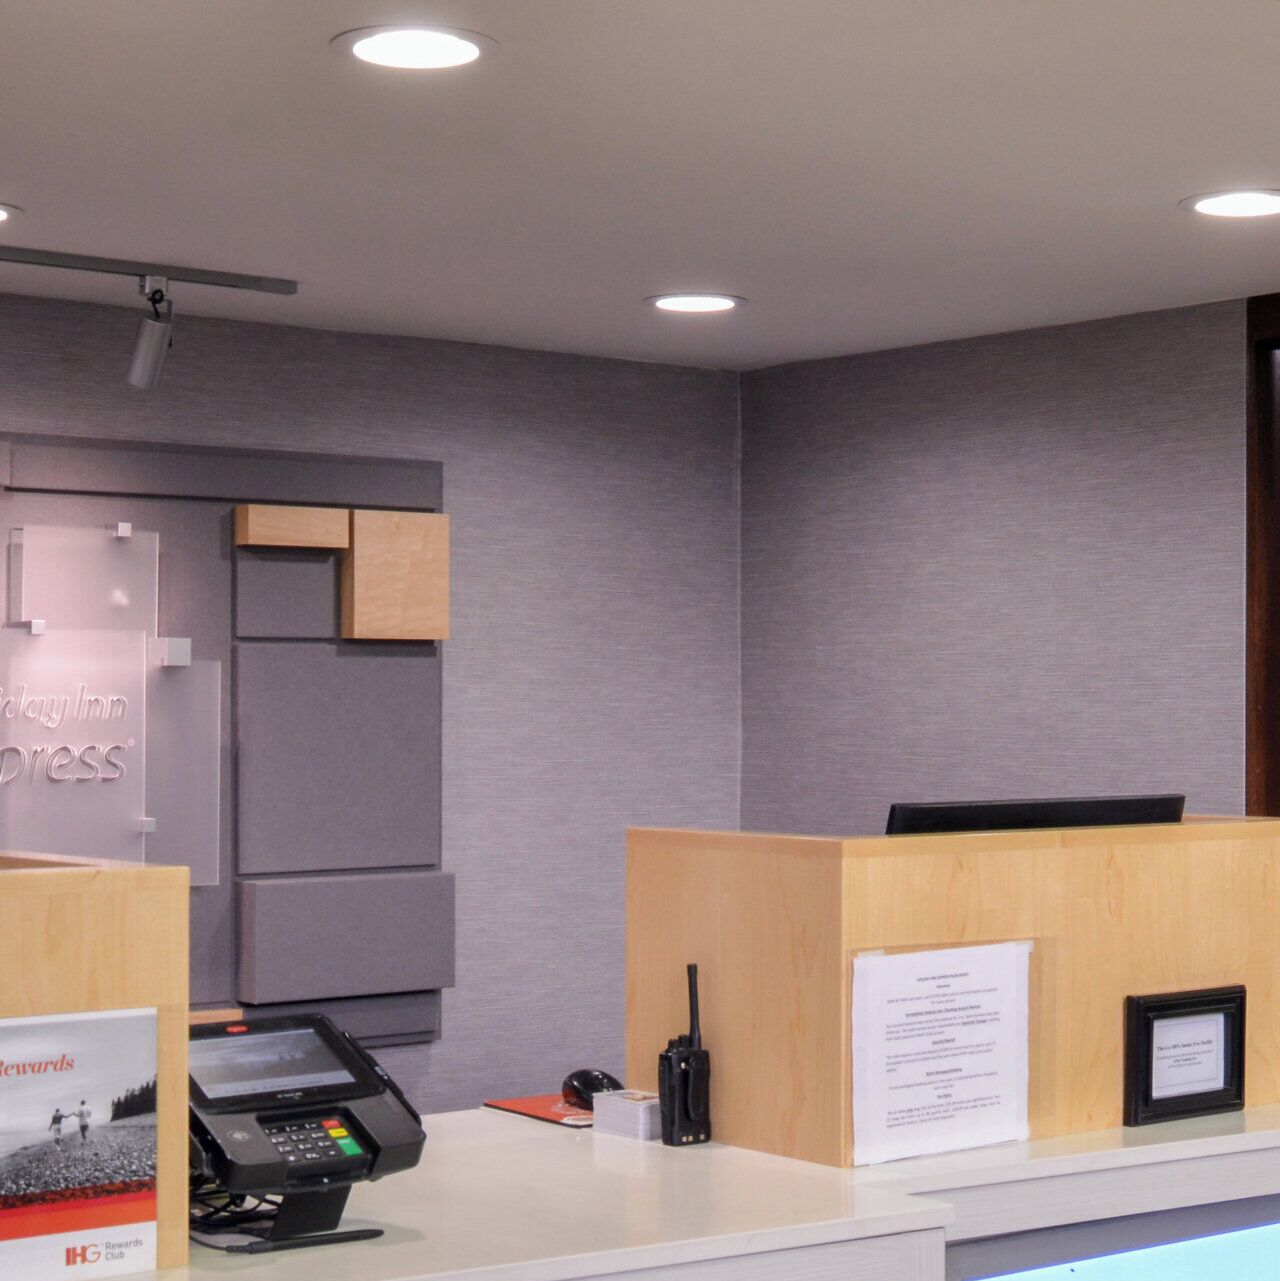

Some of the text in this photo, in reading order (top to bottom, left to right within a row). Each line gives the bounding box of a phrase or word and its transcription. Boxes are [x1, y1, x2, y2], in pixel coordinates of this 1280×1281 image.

[74, 683, 128, 721] Inn
[105, 1238, 144, 1251] Rewards
[65, 1243, 102, 1267] IHG
[105, 1251, 125, 1261] Club
